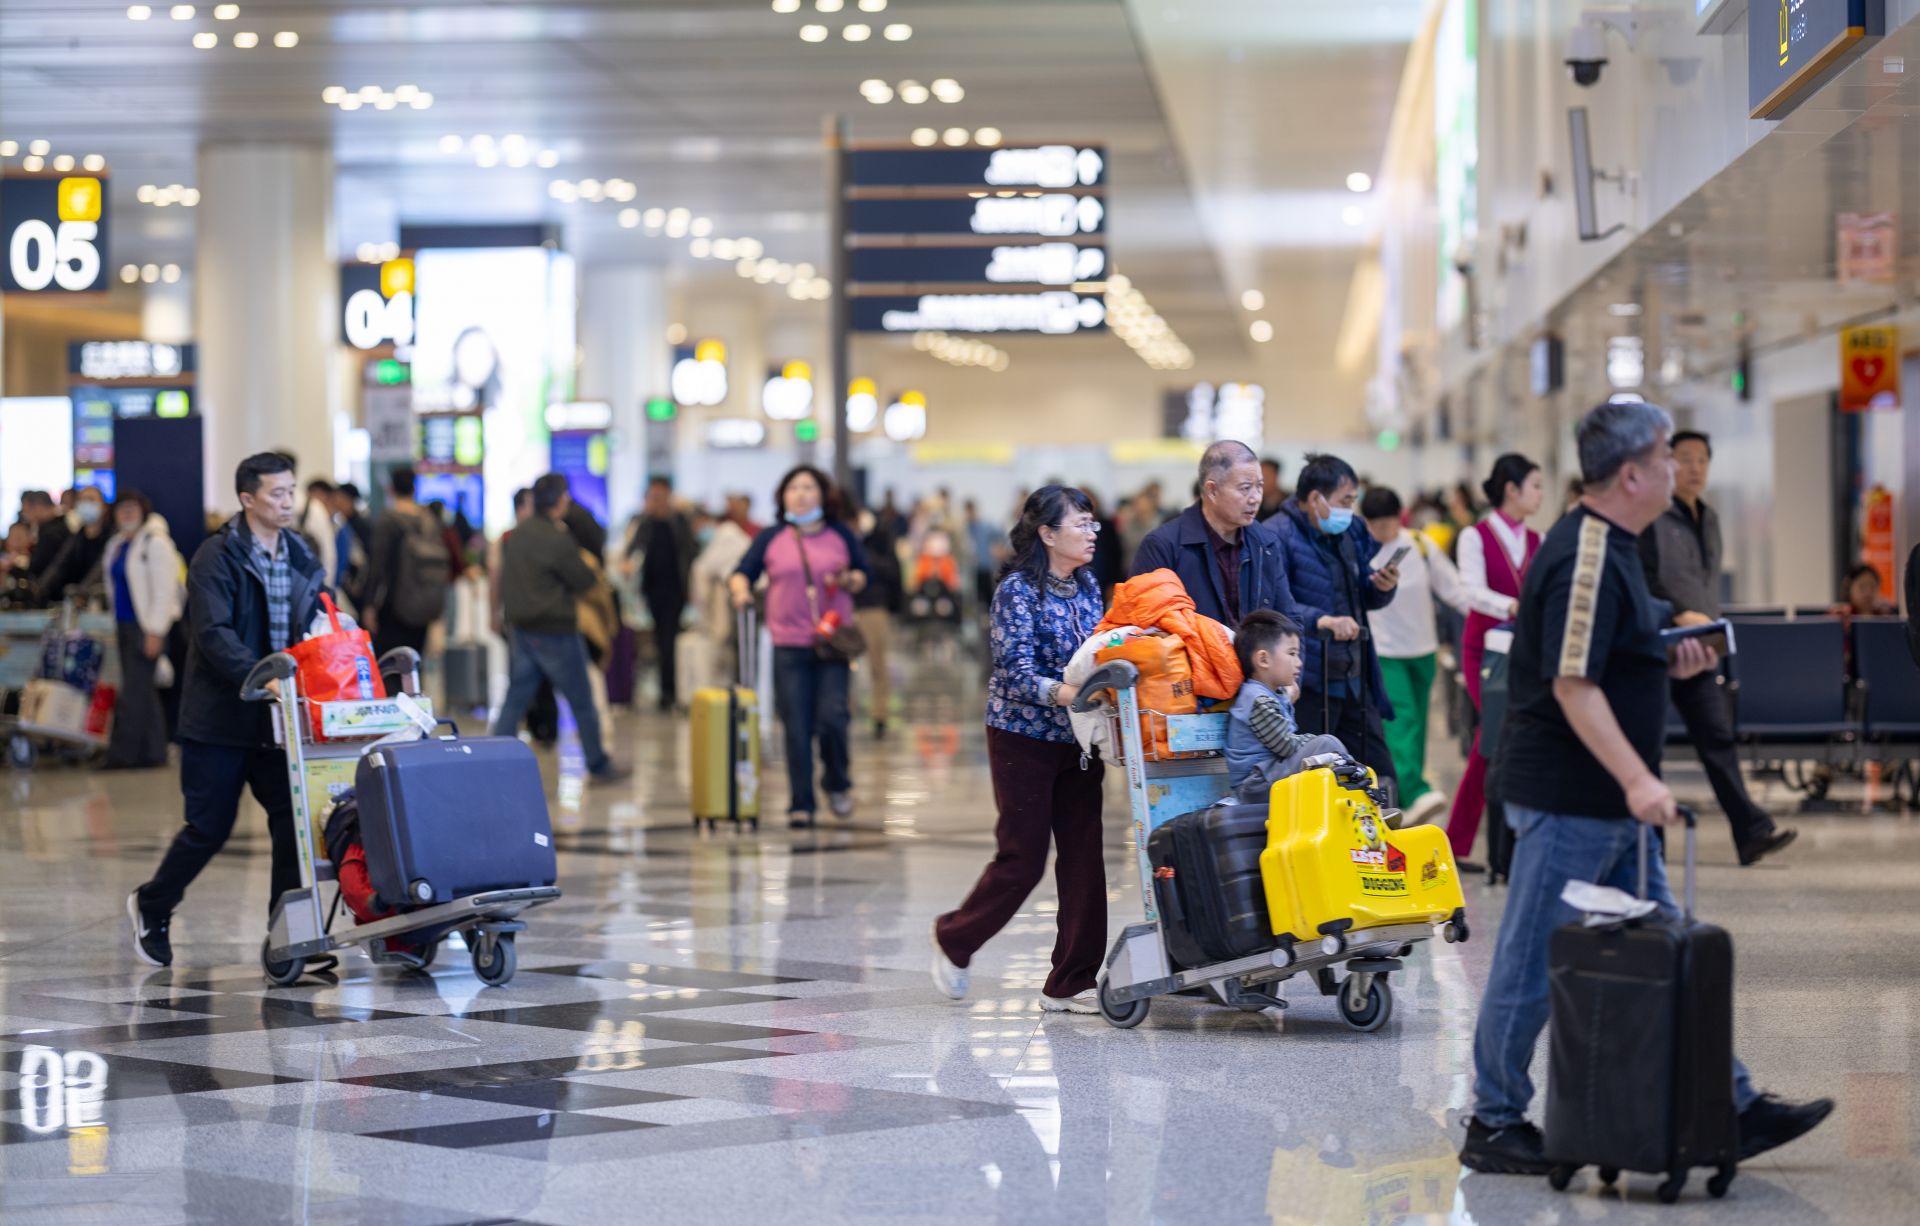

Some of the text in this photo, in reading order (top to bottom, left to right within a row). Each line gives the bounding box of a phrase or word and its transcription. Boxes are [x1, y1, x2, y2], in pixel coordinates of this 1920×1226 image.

[9, 219, 101, 291] 05
[344, 289, 415, 349] 04
[1361, 876, 1407, 891] DIGGING
